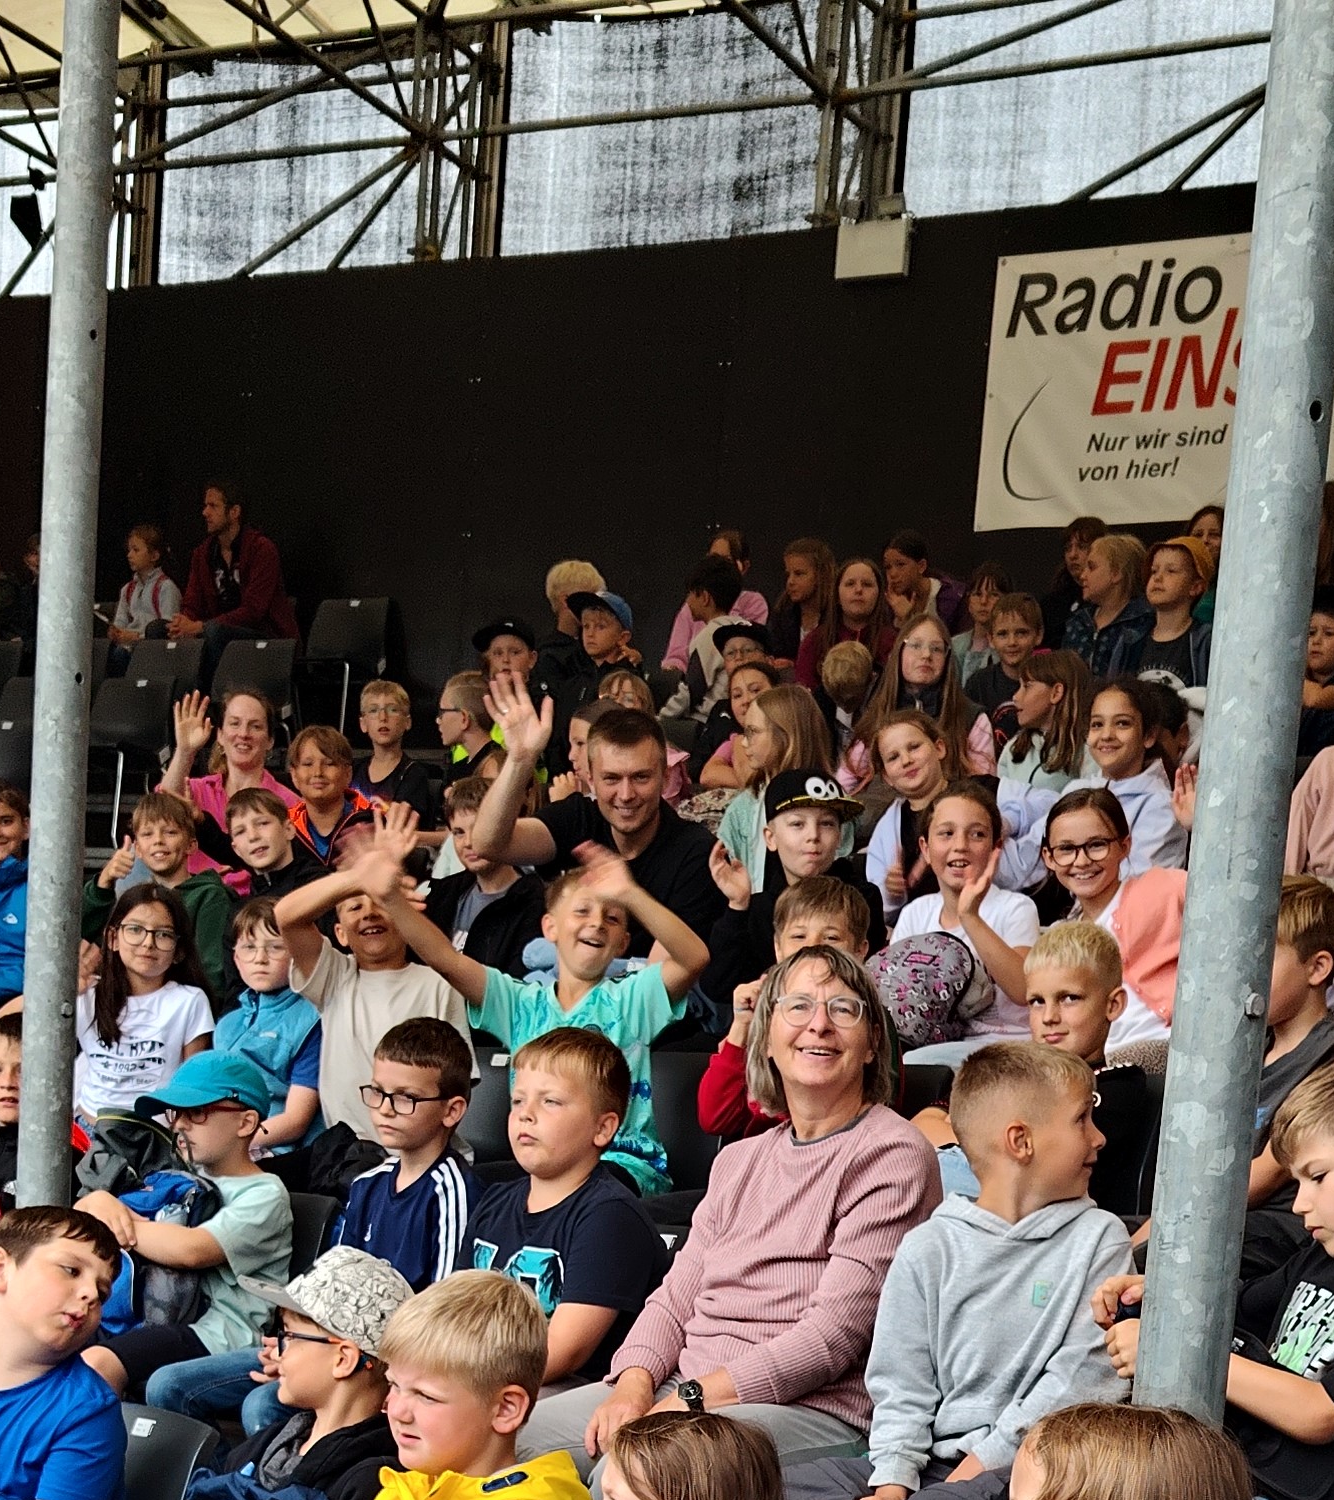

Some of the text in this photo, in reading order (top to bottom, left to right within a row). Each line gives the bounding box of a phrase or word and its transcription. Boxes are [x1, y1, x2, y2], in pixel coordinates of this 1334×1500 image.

[1005, 258, 1223, 338] Radio
[1091, 307, 1243, 416] EIN
[1086, 423, 1230, 454] Nur wir sind
[1078, 456, 1181, 482] von hier!
